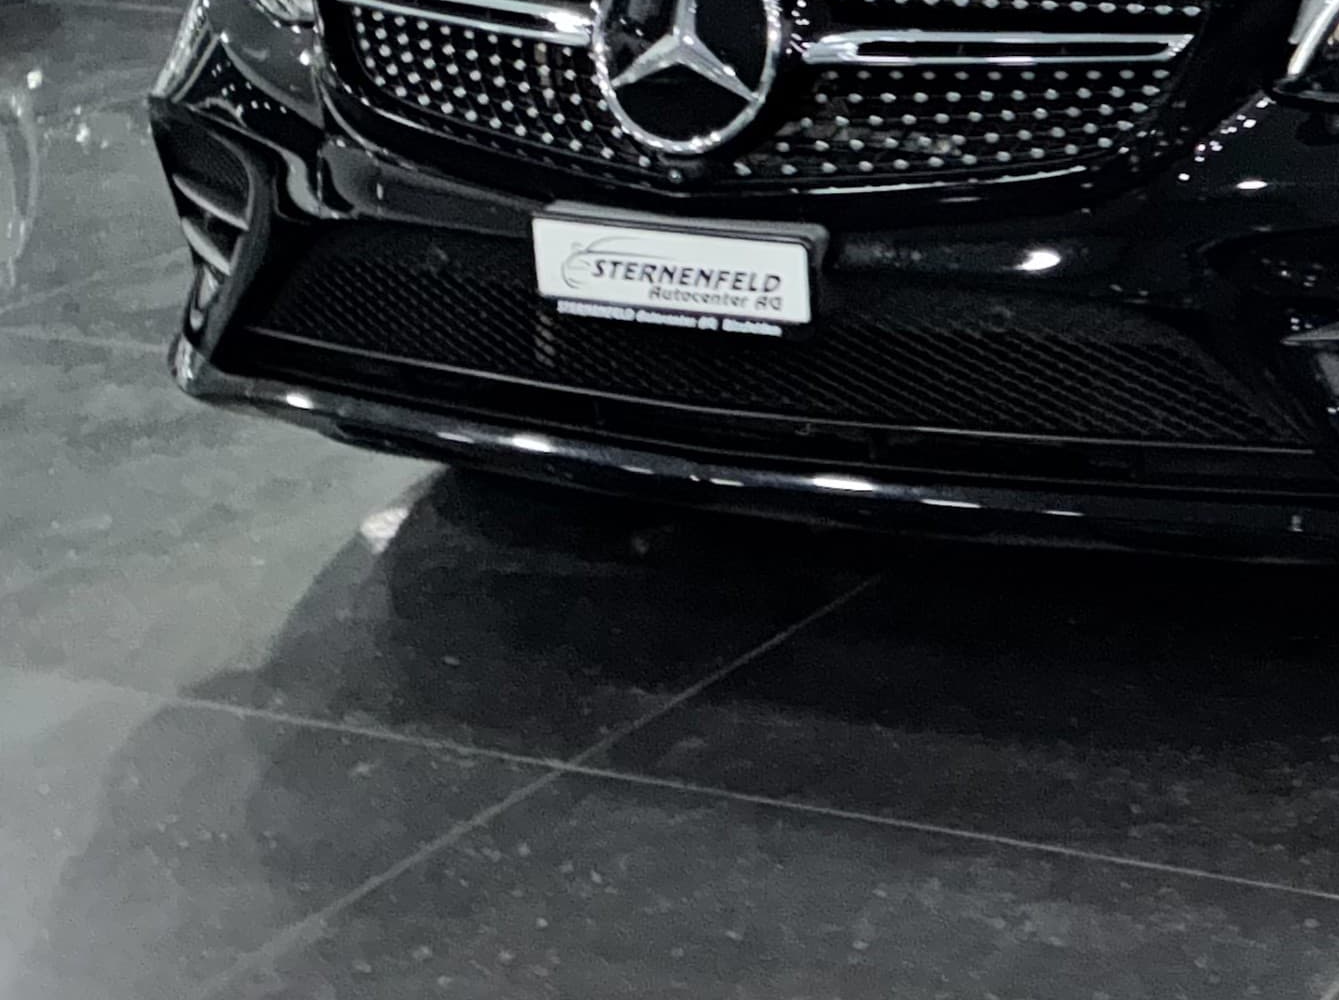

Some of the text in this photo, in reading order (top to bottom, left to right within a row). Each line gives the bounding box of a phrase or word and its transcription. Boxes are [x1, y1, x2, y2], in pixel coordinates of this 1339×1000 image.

[592, 259, 782, 293] STERNENFELD
[648, 286, 783, 312] Autocenter AG
